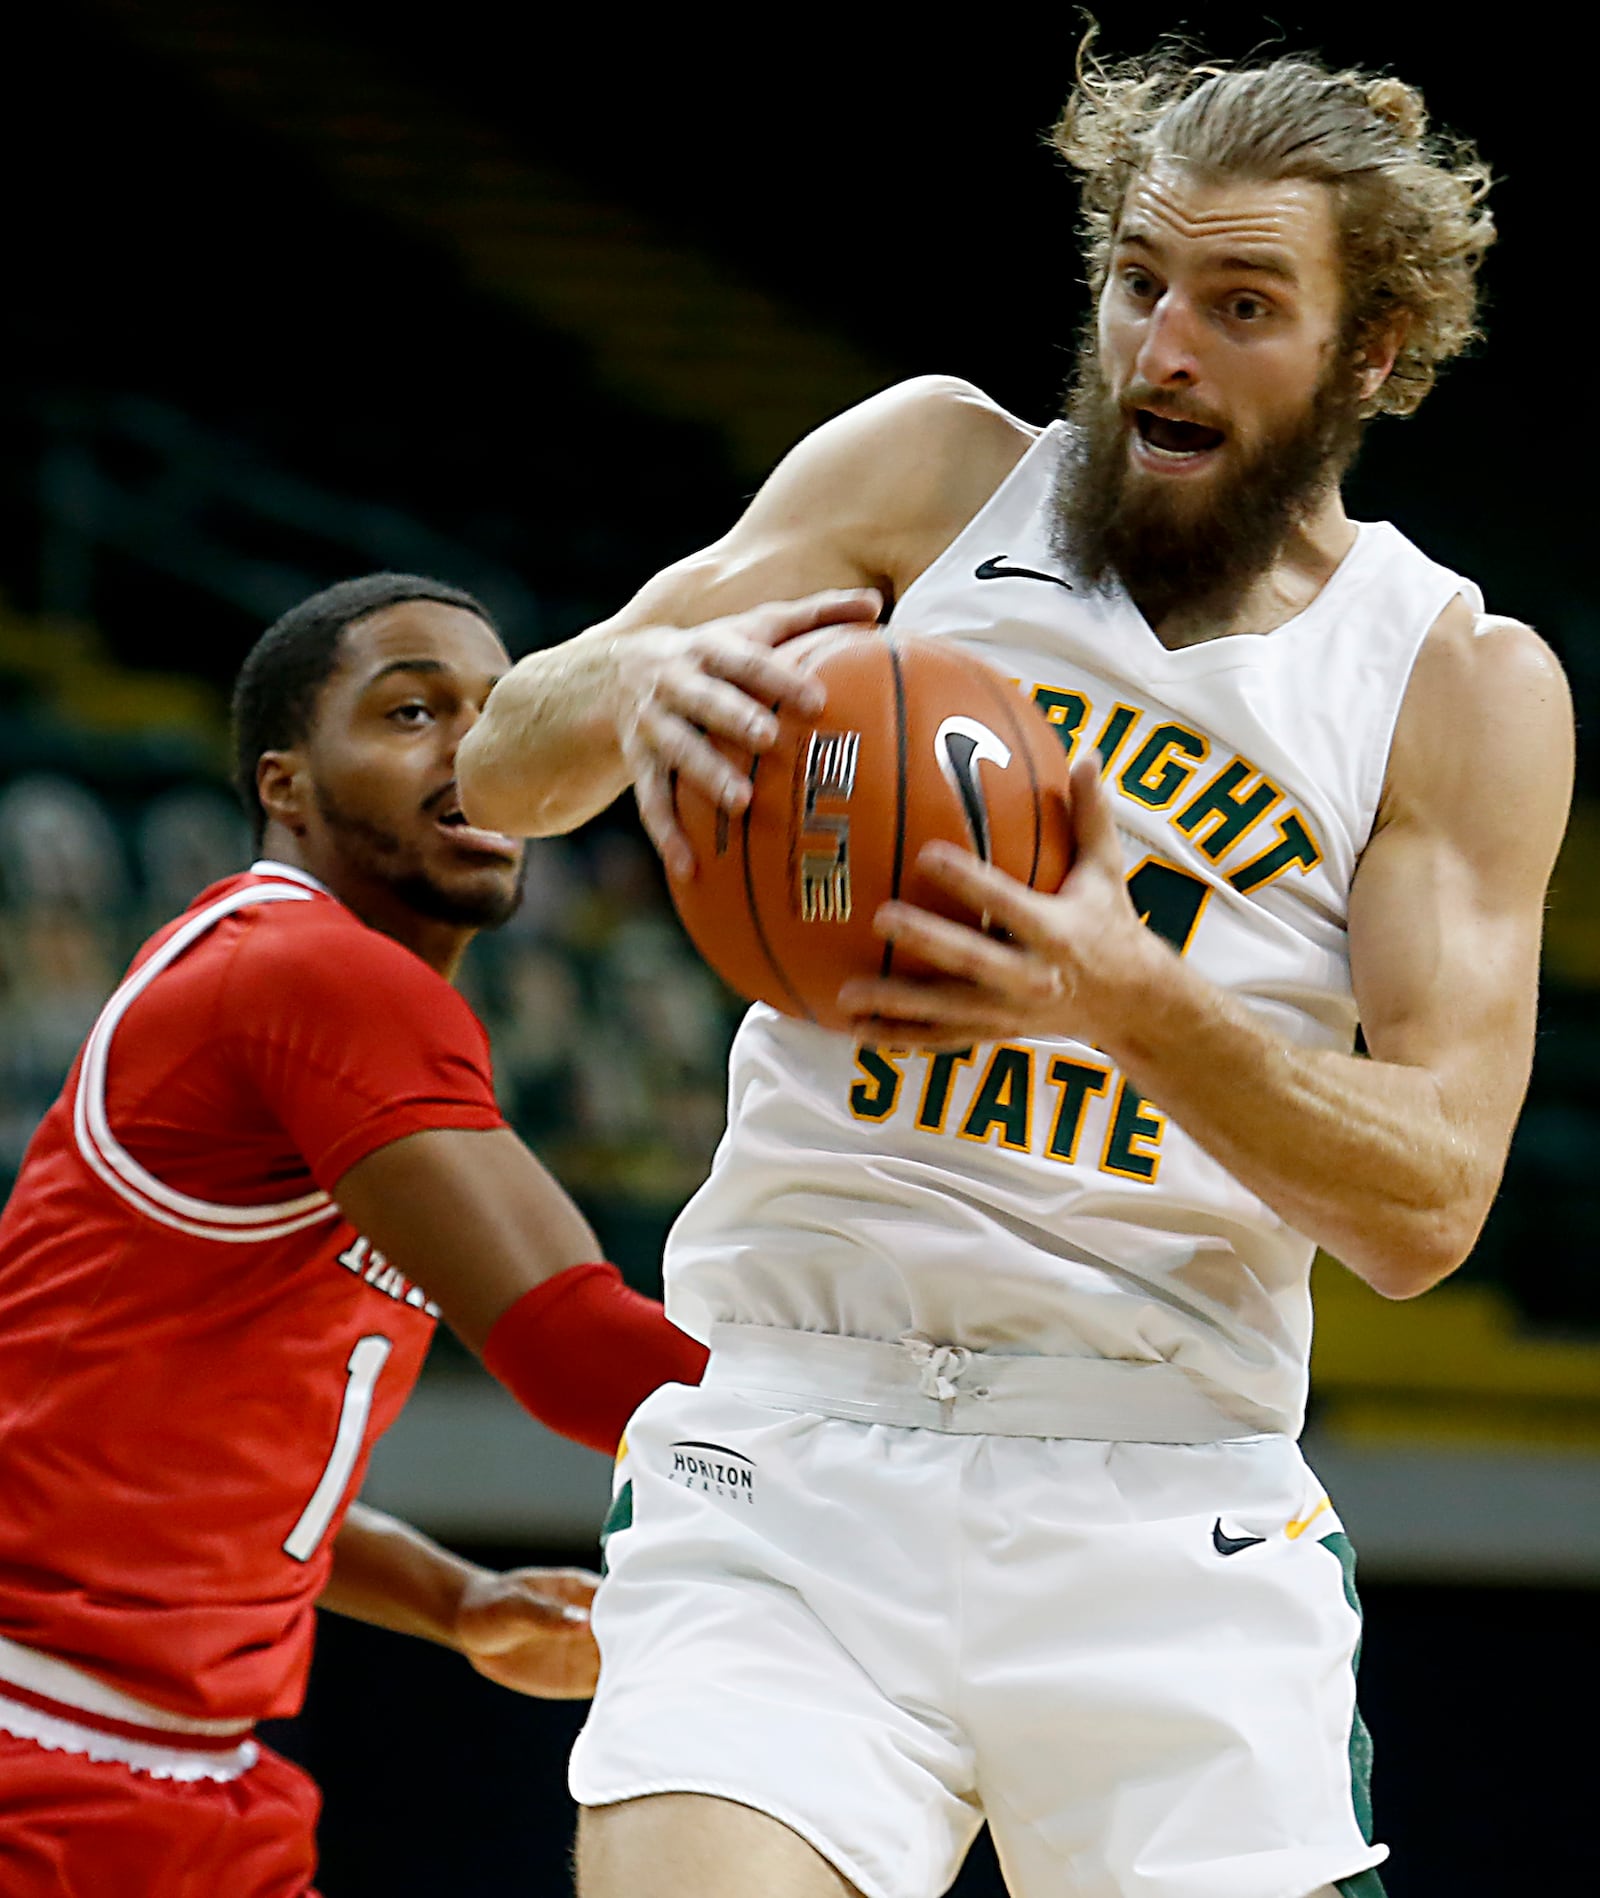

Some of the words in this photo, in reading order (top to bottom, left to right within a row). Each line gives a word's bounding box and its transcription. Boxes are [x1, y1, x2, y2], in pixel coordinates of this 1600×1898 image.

[1020, 681, 1324, 897] RIGHT
[848, 1043, 1169, 1185] STATE
[282, 1333, 393, 1563] 1
[673, 1451, 753, 1489] HORIZON
